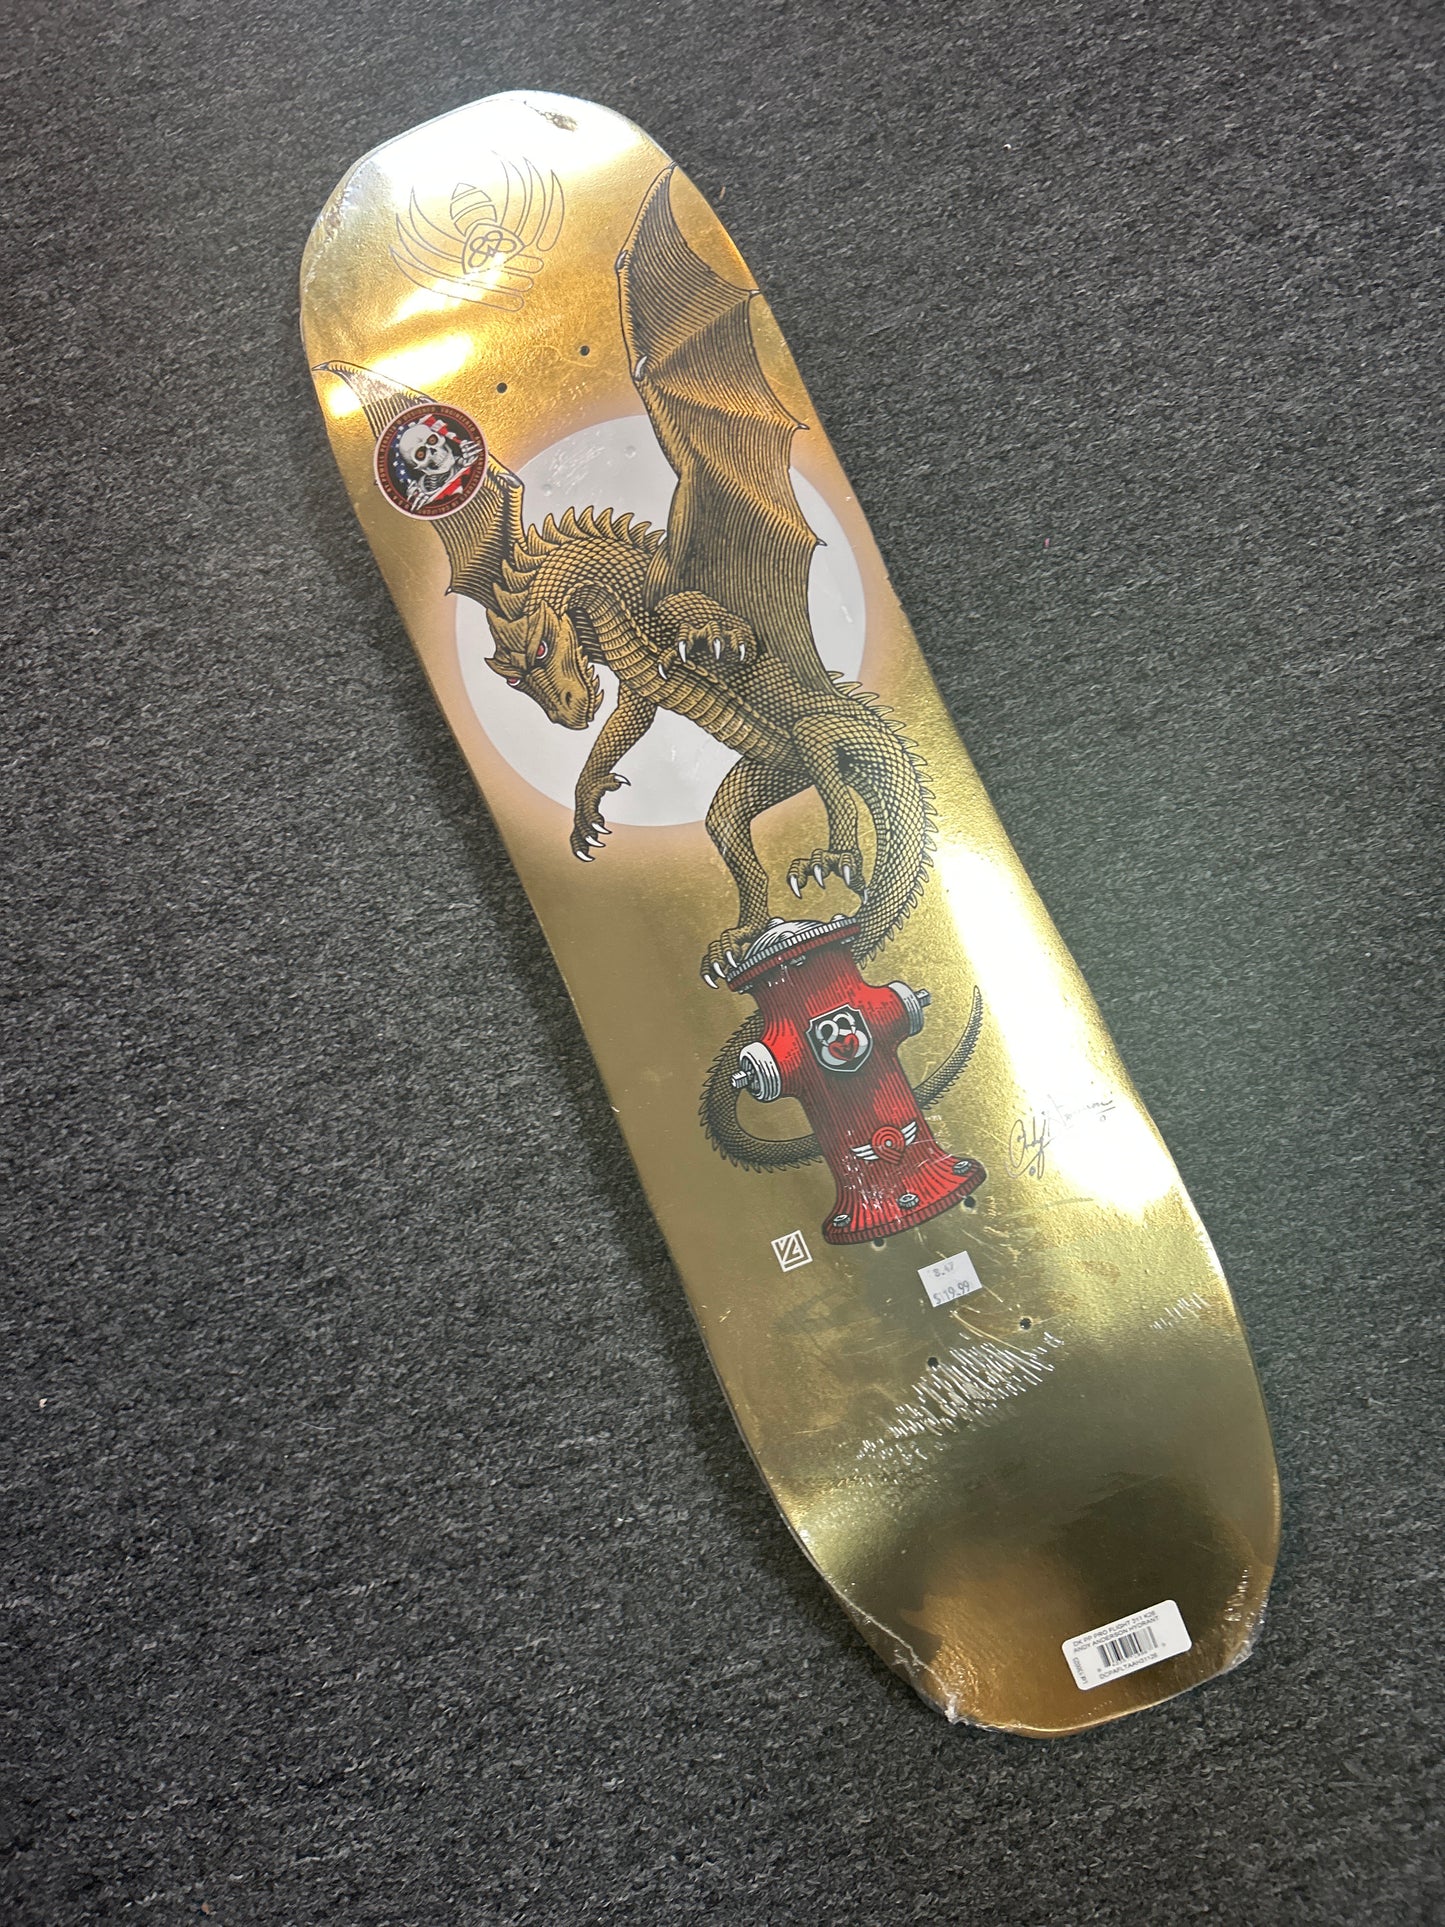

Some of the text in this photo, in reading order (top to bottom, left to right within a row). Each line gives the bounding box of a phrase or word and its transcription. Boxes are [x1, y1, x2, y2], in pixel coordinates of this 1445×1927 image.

[1073, 1615, 1159, 1653] ANDY ANDERSON HYDRANT
[1093, 1629, 1108, 1638] PRO
[1108, 1620, 1131, 1632] FLIGHT
